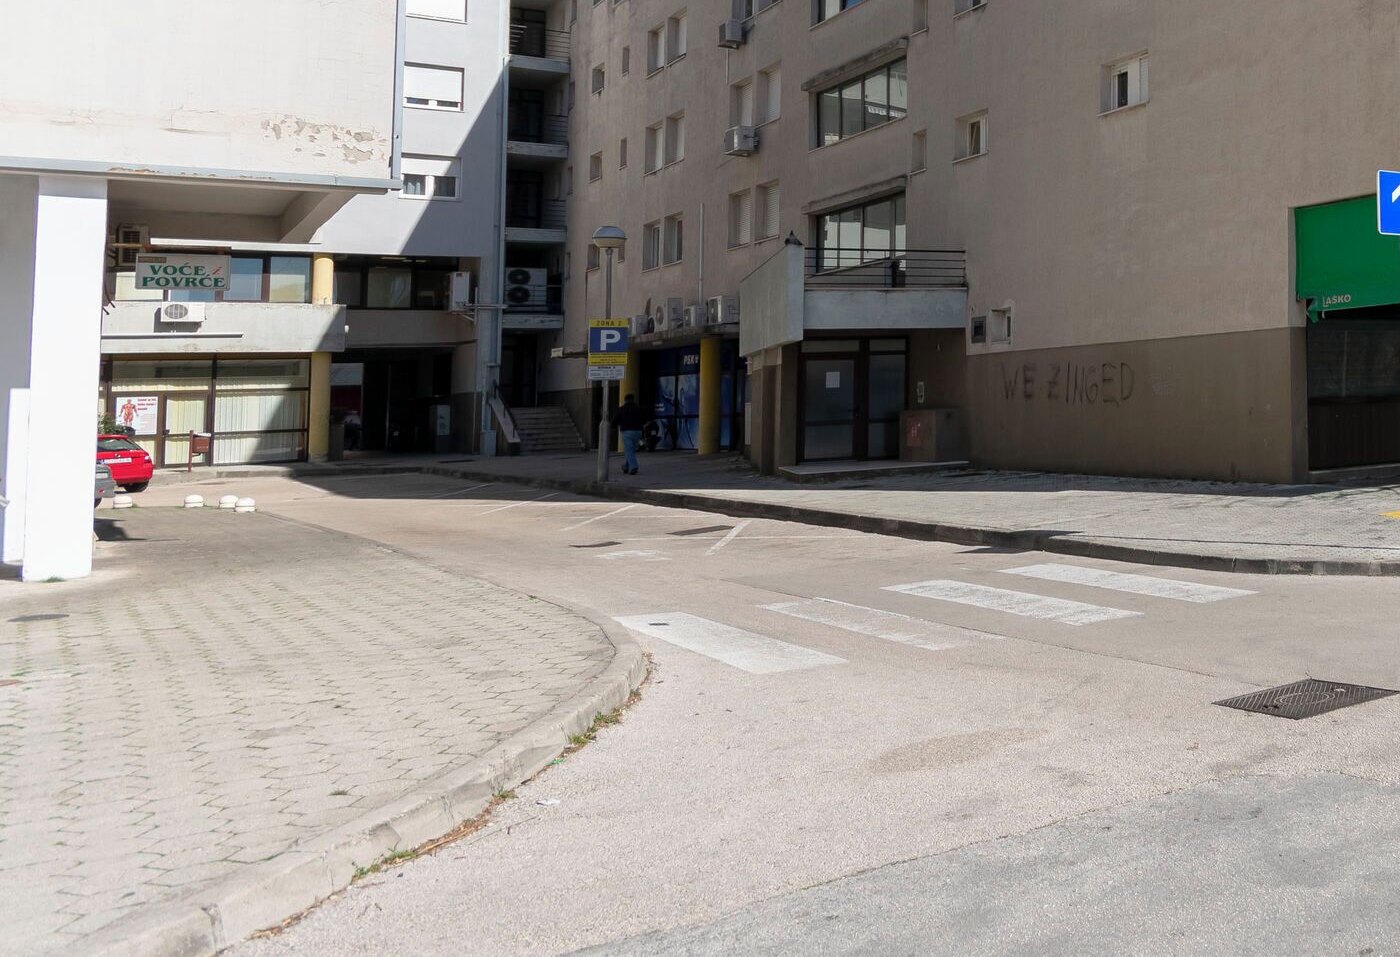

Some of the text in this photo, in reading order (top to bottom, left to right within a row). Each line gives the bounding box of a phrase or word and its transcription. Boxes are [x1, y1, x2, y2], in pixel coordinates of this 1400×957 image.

[150, 263, 206, 276] VOĆE
[142, 274, 226, 288] POVRĆE
[600, 329, 621, 351] P
